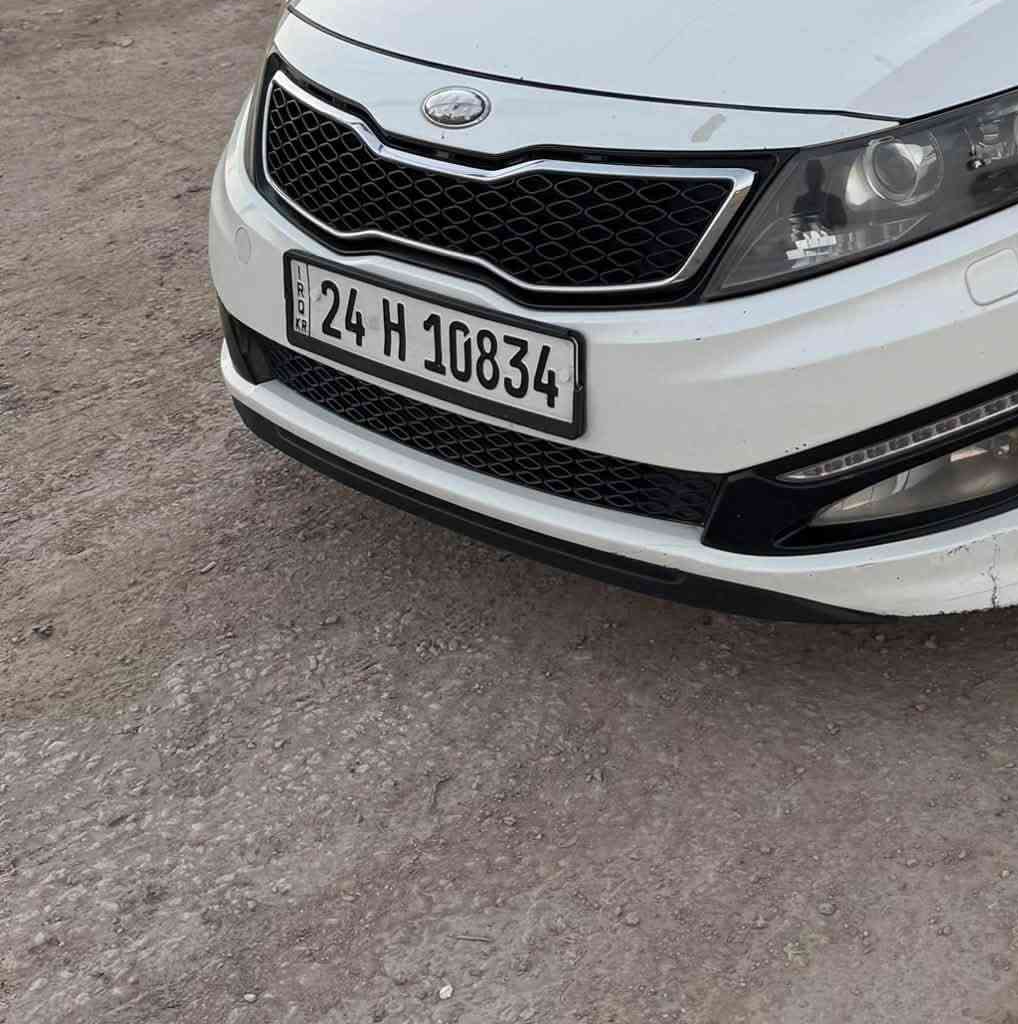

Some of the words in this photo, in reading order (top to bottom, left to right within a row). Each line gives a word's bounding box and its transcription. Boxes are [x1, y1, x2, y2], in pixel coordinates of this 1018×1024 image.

[320, 279, 365, 346] 24
[382, 297, 406, 362] H
[423, 313, 559, 408] 10834
